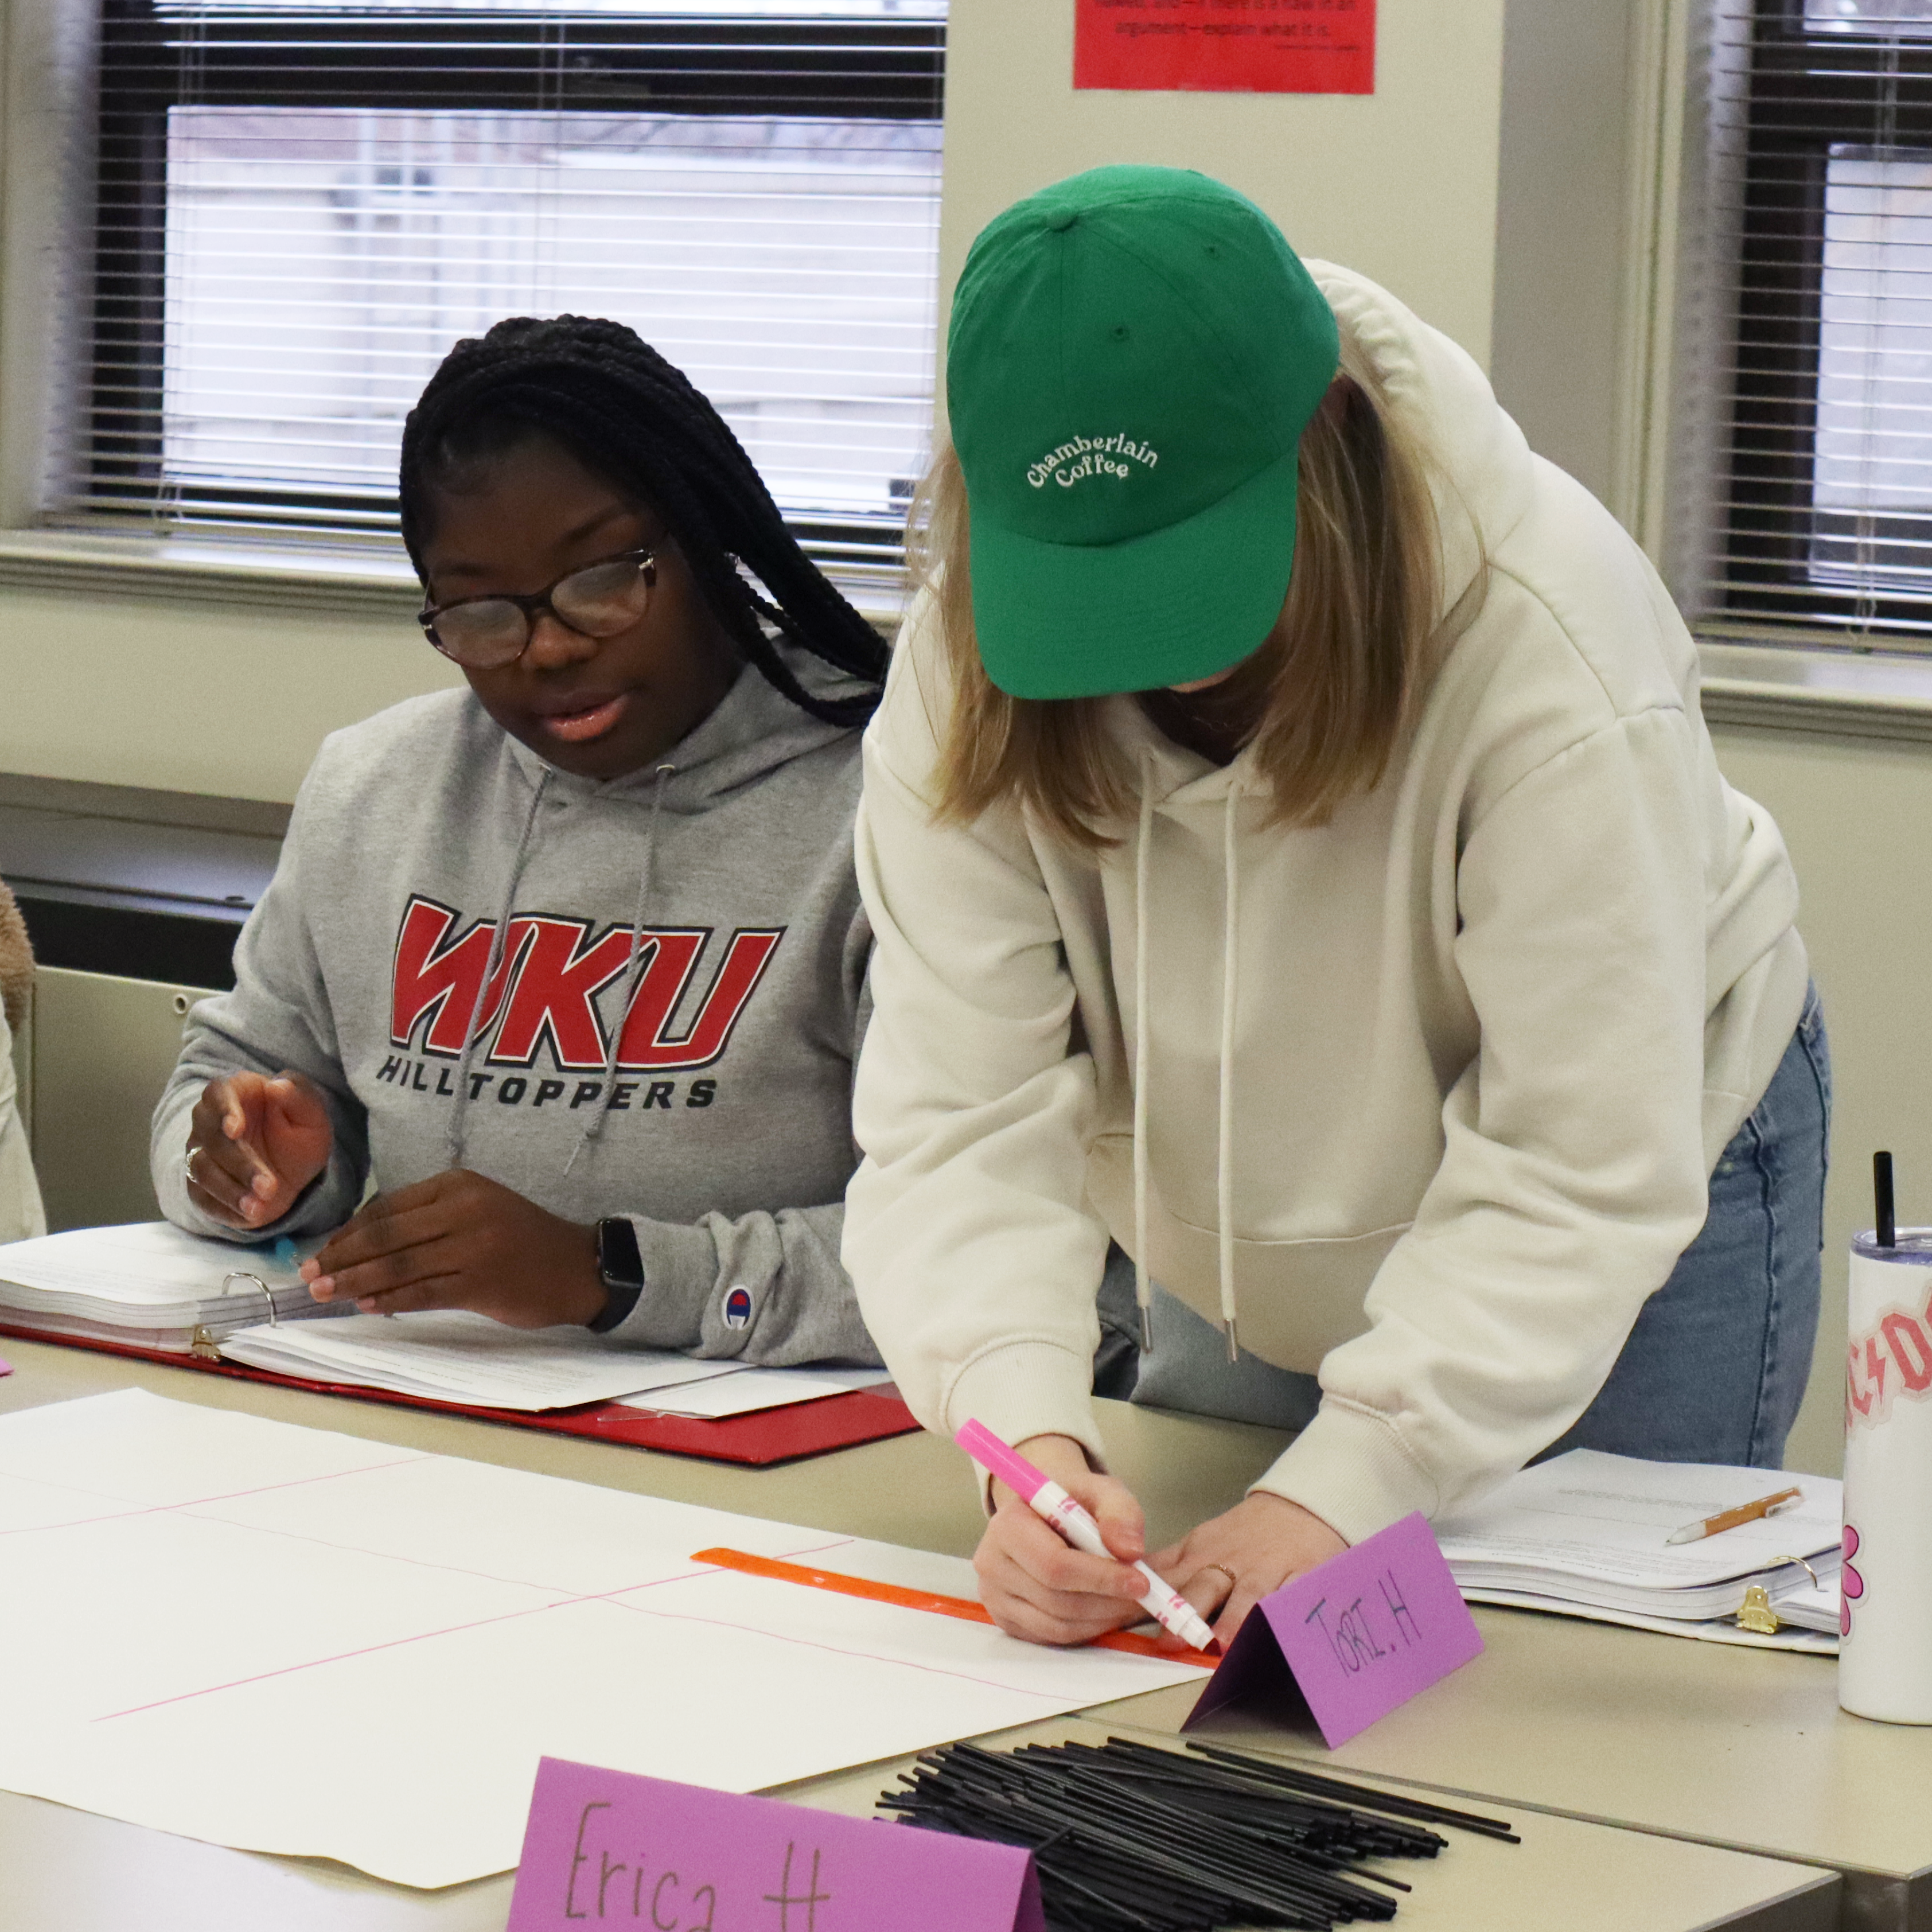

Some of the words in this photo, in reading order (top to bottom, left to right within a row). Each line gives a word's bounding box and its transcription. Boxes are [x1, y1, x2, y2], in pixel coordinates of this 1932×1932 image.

[1027, 433, 1158, 488] Chamberlain
[1055, 453, 1129, 488] Coffee
[390, 893, 789, 1074] WKU
[376, 1054, 717, 1109] HILLTOPPERS
[565, 1801, 716, 1932] Erica
[763, 1841, 831, 1932] H
